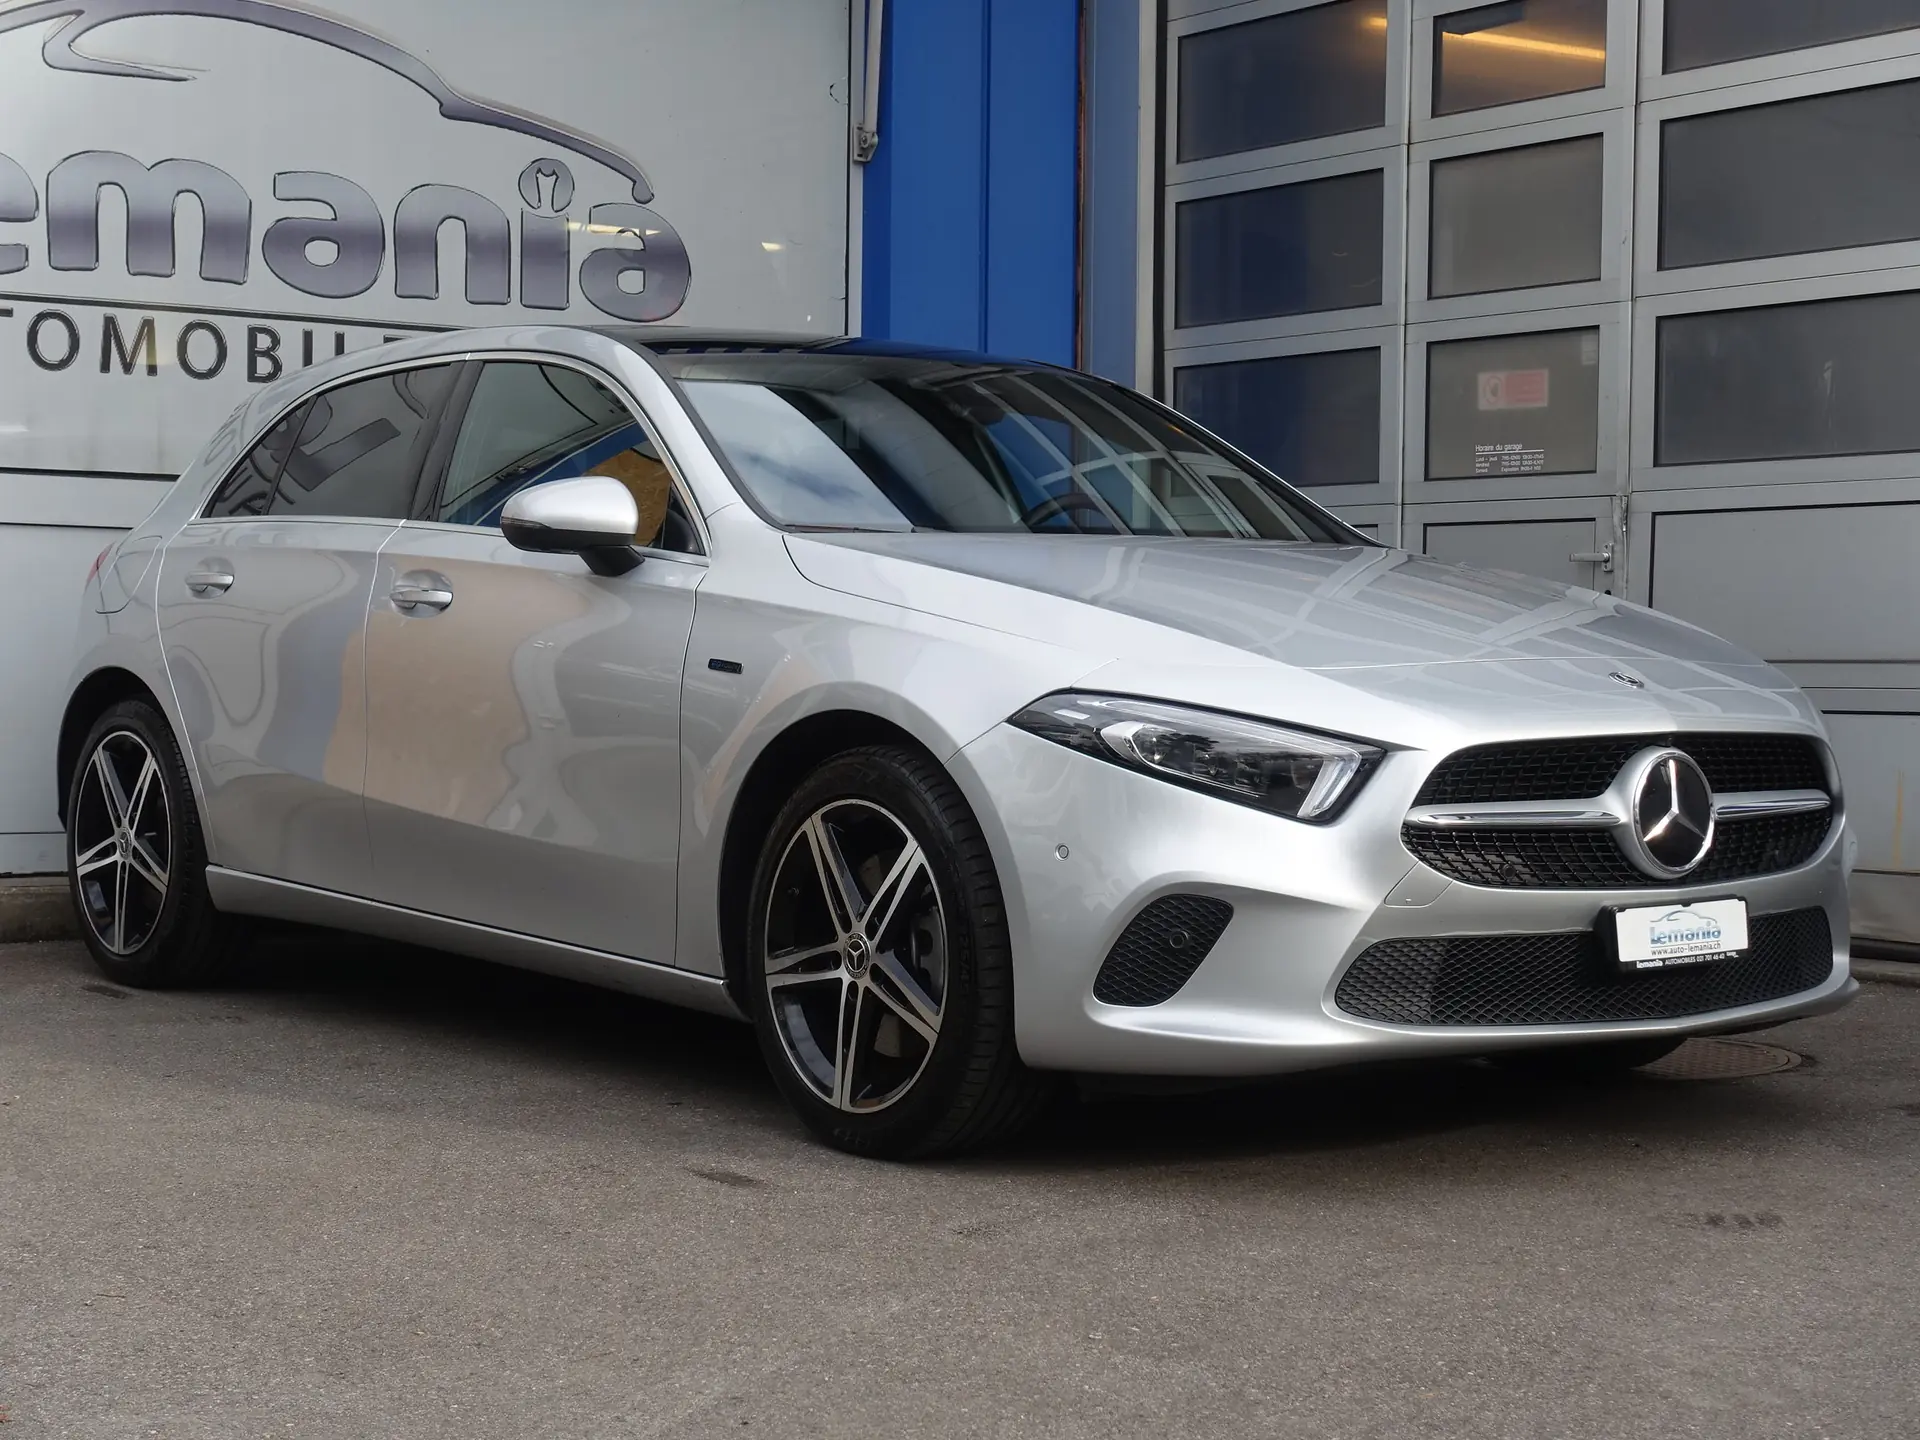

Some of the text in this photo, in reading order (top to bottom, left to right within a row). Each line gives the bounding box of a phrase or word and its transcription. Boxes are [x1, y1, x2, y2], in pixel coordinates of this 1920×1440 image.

[1475, 442, 1523, 453] Horaire du garage
[1649, 921, 1721, 945] Lemania
[1651, 941, 1721, 956] www.auto-lemania.ch
